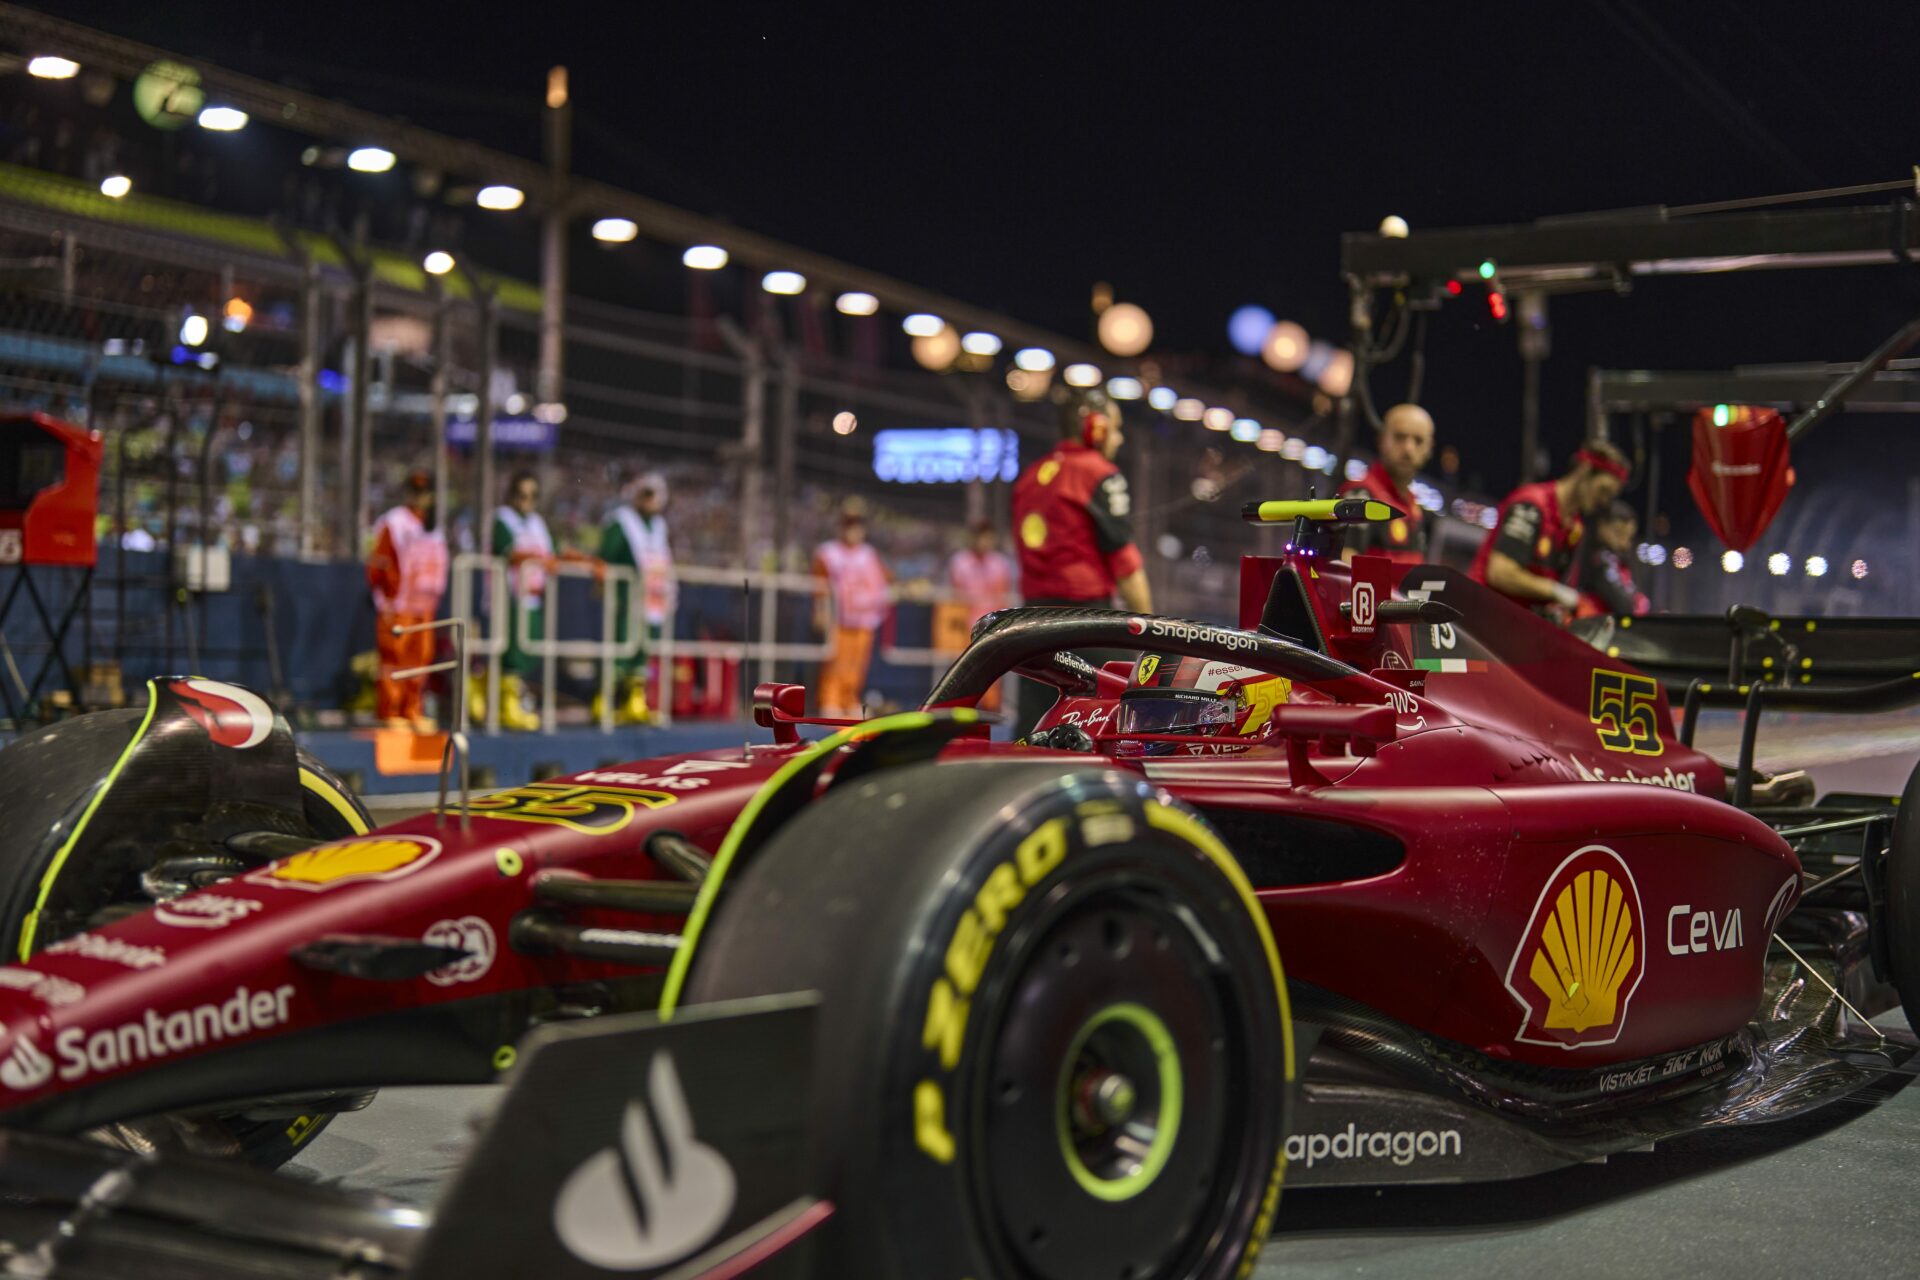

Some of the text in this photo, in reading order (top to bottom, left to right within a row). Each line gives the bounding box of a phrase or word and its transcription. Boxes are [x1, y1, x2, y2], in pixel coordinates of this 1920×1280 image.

[1151, 619, 1258, 651] Snapdragon
[1175, 693, 1200, 701] RICHARD
[1384, 691, 1419, 714] aws
[1590, 667, 1664, 757] 55
[1061, 707, 1110, 728] Ray-Ban
[921, 816, 1070, 1071] ZERO
[56, 985, 296, 1081] Santander
